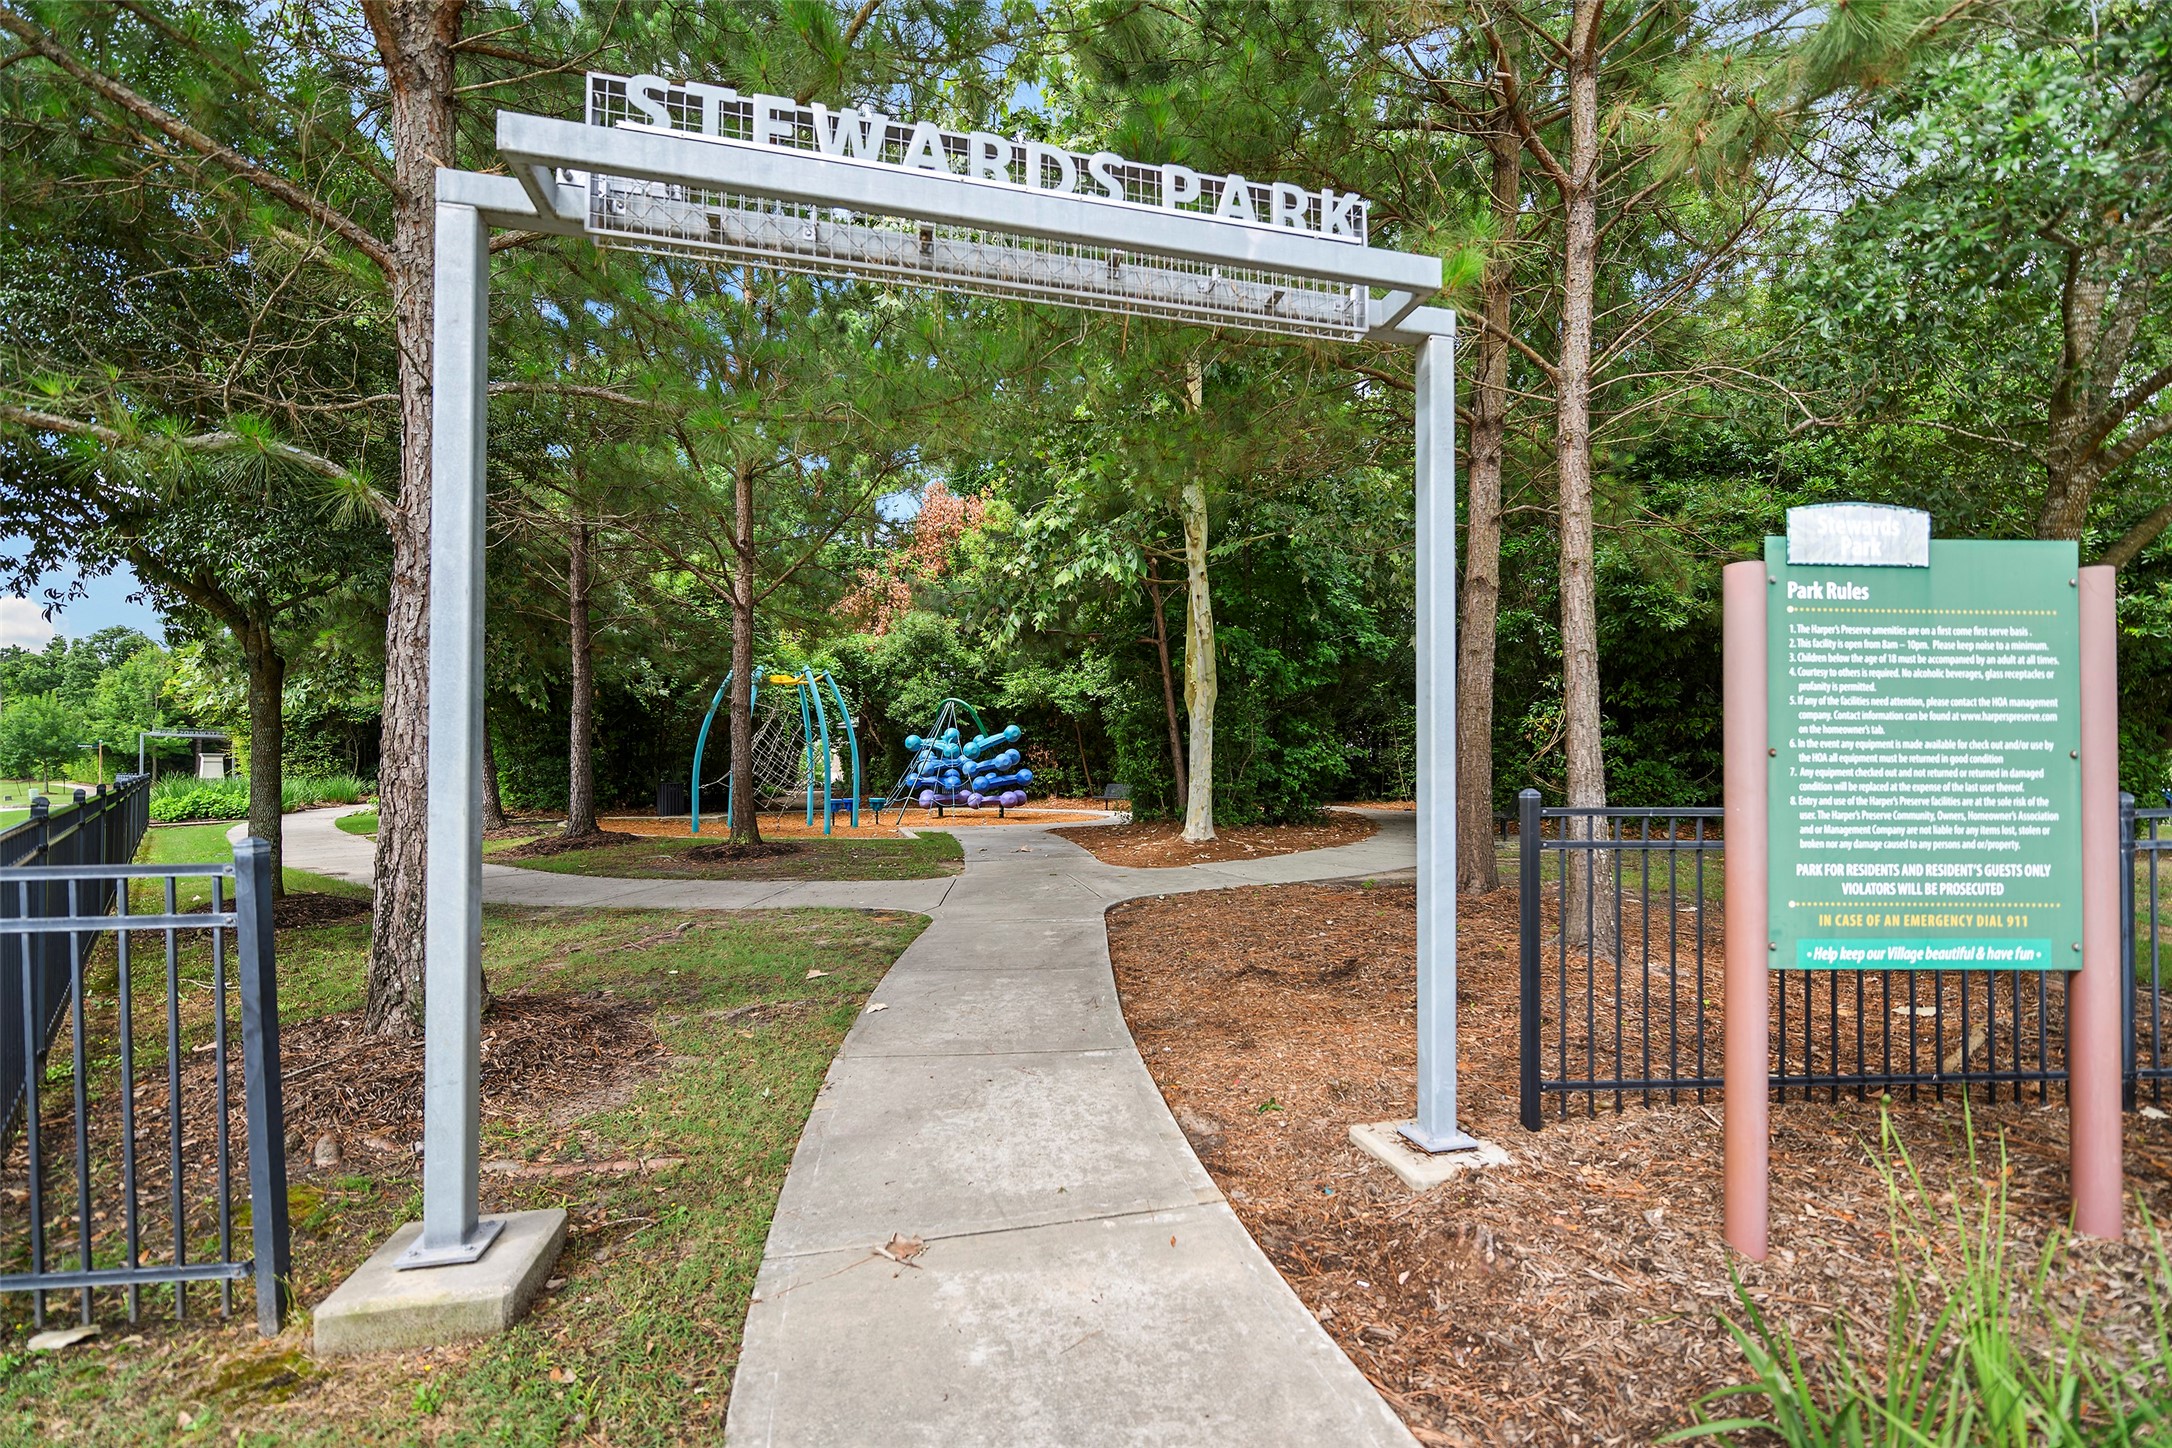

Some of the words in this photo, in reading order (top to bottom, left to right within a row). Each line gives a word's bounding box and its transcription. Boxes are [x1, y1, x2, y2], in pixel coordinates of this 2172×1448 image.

[625, 74, 1124, 201] STEWARDS
[1162, 163, 1360, 238] PARK
[1817, 514, 1900, 537] Stewards
[1841, 534, 1882, 557] Park
[1787, 581, 1823, 599] Park
[1826, 582, 1869, 600] Rules
[1789, 624, 1796, 633] 1.
[1797, 624, 1810, 633] The
[1811, 625, 1840, 636] Harper's
[1841, 625, 1871, 634] Preserve
[1872, 626, 1906, 635] amenities
[1937, 626, 1951, 635] first
[1953, 628, 1972, 636] come
[1974, 626, 1988, 636] first
[1989, 628, 2008, 636] serve
[2010, 626, 2028, 636] basis
[1789, 638, 1796, 648] 2.
[1797, 638, 1811, 648] This
[1812, 638, 1836, 650] facility
[1838, 639, 1843, 648] is
[1844, 641, 1862, 650] open
[1864, 639, 1880, 649] from
[1882, 640, 1898, 649] 8am
[1907, 640, 1929, 651] 10pm.
[1933, 640, 1955, 650] Please
[1957, 640, 1974, 652] keep
[1975, 640, 1994, 650] noise
[1996, 641, 2004, 650] to
[2011, 641, 2049, 650] minimum.
[1789, 667, 1796, 676] 4.
[1797, 667, 1828, 678] Courtesy
[1829, 668, 1836, 677] to
[1838, 668, 1860, 677] others
[1862, 668, 1867, 677] is
[1869, 668, 1900, 679] required.
[1902, 668, 1912, 677] No
[1913, 668, 1944, 678] alcoholic
[1945, 669, 1984, 680] beverages,
[1985, 669, 2003, 680] glass
[2005, 669, 2045, 680] receptacles
[2046, 671, 2054, 679] or
[1799, 681, 1831, 693] profanity
[1832, 682, 1838, 691] is
[1839, 682, 1876, 693] permitted.
[1789, 696, 1796, 705] 5.
[1798, 695, 1804, 704] If
[1804, 698, 1817, 707] any
[1818, 696, 1827, 705] of
[1827, 696, 1839, 705] the
[1840, 696, 1870, 706] facilities
[1871, 697, 1889, 706] need
[1890, 697, 1925, 707] attention,
[1926, 697, 1949, 708] please
[1951, 698, 1977, 707] contact
[1978, 697, 1990, 707] the
[1992, 697, 2008, 707] HOA
[2009, 699, 2058, 709] management
[1798, 712, 1832, 721] company.
[1834, 710, 1860, 720] Contact
[1862, 710, 1903, 720] information
[1919, 711, 1928, 720] be
[1929, 711, 1951, 721] found
[1952, 712, 1960, 721] at
[1960, 711, 2057, 723] www.harperspreserve.com
[1809, 724, 1821, 734] the
[1823, 725, 1870, 734] homeowner's
[1871, 725, 1885, 734] tab.
[1790, 796, 1797, 805] 8.
[1798, 796, 1817, 807] Entry
[1818, 796, 1832, 805] and
[1847, 796, 1855, 805] of
[1856, 796, 1868, 805] the
[1869, 796, 1898, 807] Harper's
[1900, 796, 1930, 806] Preserve
[1931, 796, 1960, 806] facilities
[1975, 798, 1982, 806] at
[1984, 797, 1996, 806] the
[1997, 797, 2012, 806] sole
[2013, 797, 2026, 806] risk
[2027, 797, 2036, 806] of
[2037, 797, 2049, 806] the
[1817, 810, 1830, 819] The
[1832, 810, 1860, 821] Harper's
[1861, 810, 1891, 820] Preserve
[1893, 810, 1935, 822] Community,
[1937, 811, 1966, 821] Owners,
[1968, 811, 2017, 820] Homeowner's
[2018, 811, 2059, 821] Association
[1799, 825, 1813, 834] and
[1824, 825, 1871, 836] Management
[1872, 825, 1905, 836] Company
[1919, 826, 1931, 834] not
[1933, 825, 1952, 834] liable
[1954, 825, 1964, 834] for
[1966, 827, 1979, 837] any
[1980, 826, 2000, 835] items
[2001, 825, 2017, 836] lost,
[2018, 826, 2041, 835] stolen
[2042, 827, 2050, 835] or
[1800, 839, 1824, 848] broken
[1839, 841, 1852, 850] any
[1853, 839, 1882, 850] damage
[1884, 839, 1908, 849] caused
[1909, 840, 1917, 849] to
[1918, 841, 1931, 850] any
[1933, 841, 1960, 850] persons
[1962, 839, 1975, 849] and
[1977, 840, 2020, 851] or/property.
[1796, 864, 1822, 876] PARK
[1824, 864, 1844, 876] FOR
[1846, 864, 1900, 876] RESIDENTS
[1902, 864, 1923, 876] AND
[1926, 864, 1982, 876] RESIDENT'S
[1984, 864, 2022, 877] GUESTS
[2024, 864, 2051, 877] ONLY
[1841, 883, 1896, 895] VIOLATORS
[1898, 883, 1922, 895] WILL
[1925, 883, 1937, 895] BE
[1940, 883, 2004, 895] PROSECUTED
[1819, 914, 1831, 926] IN
[1835, 914, 1863, 926] CASE
[1866, 914, 1880, 926] OF
[1884, 915, 1900, 926] AN
[1904, 914, 1973, 927] EMERGENCY
[1976, 915, 2003, 927] DIAL
[2007, 915, 2028, 927] 911
[1813, 947, 1838, 963] Help
[1840, 947, 1865, 963] keep
[1866, 950, 1885, 959] our
[1888, 947, 1924, 963] Village
[1925, 947, 1975, 959] beautiful
[1976, 947, 1985, 959] &
[1987, 947, 2013, 960] have
[2015, 947, 2034, 960] fun
